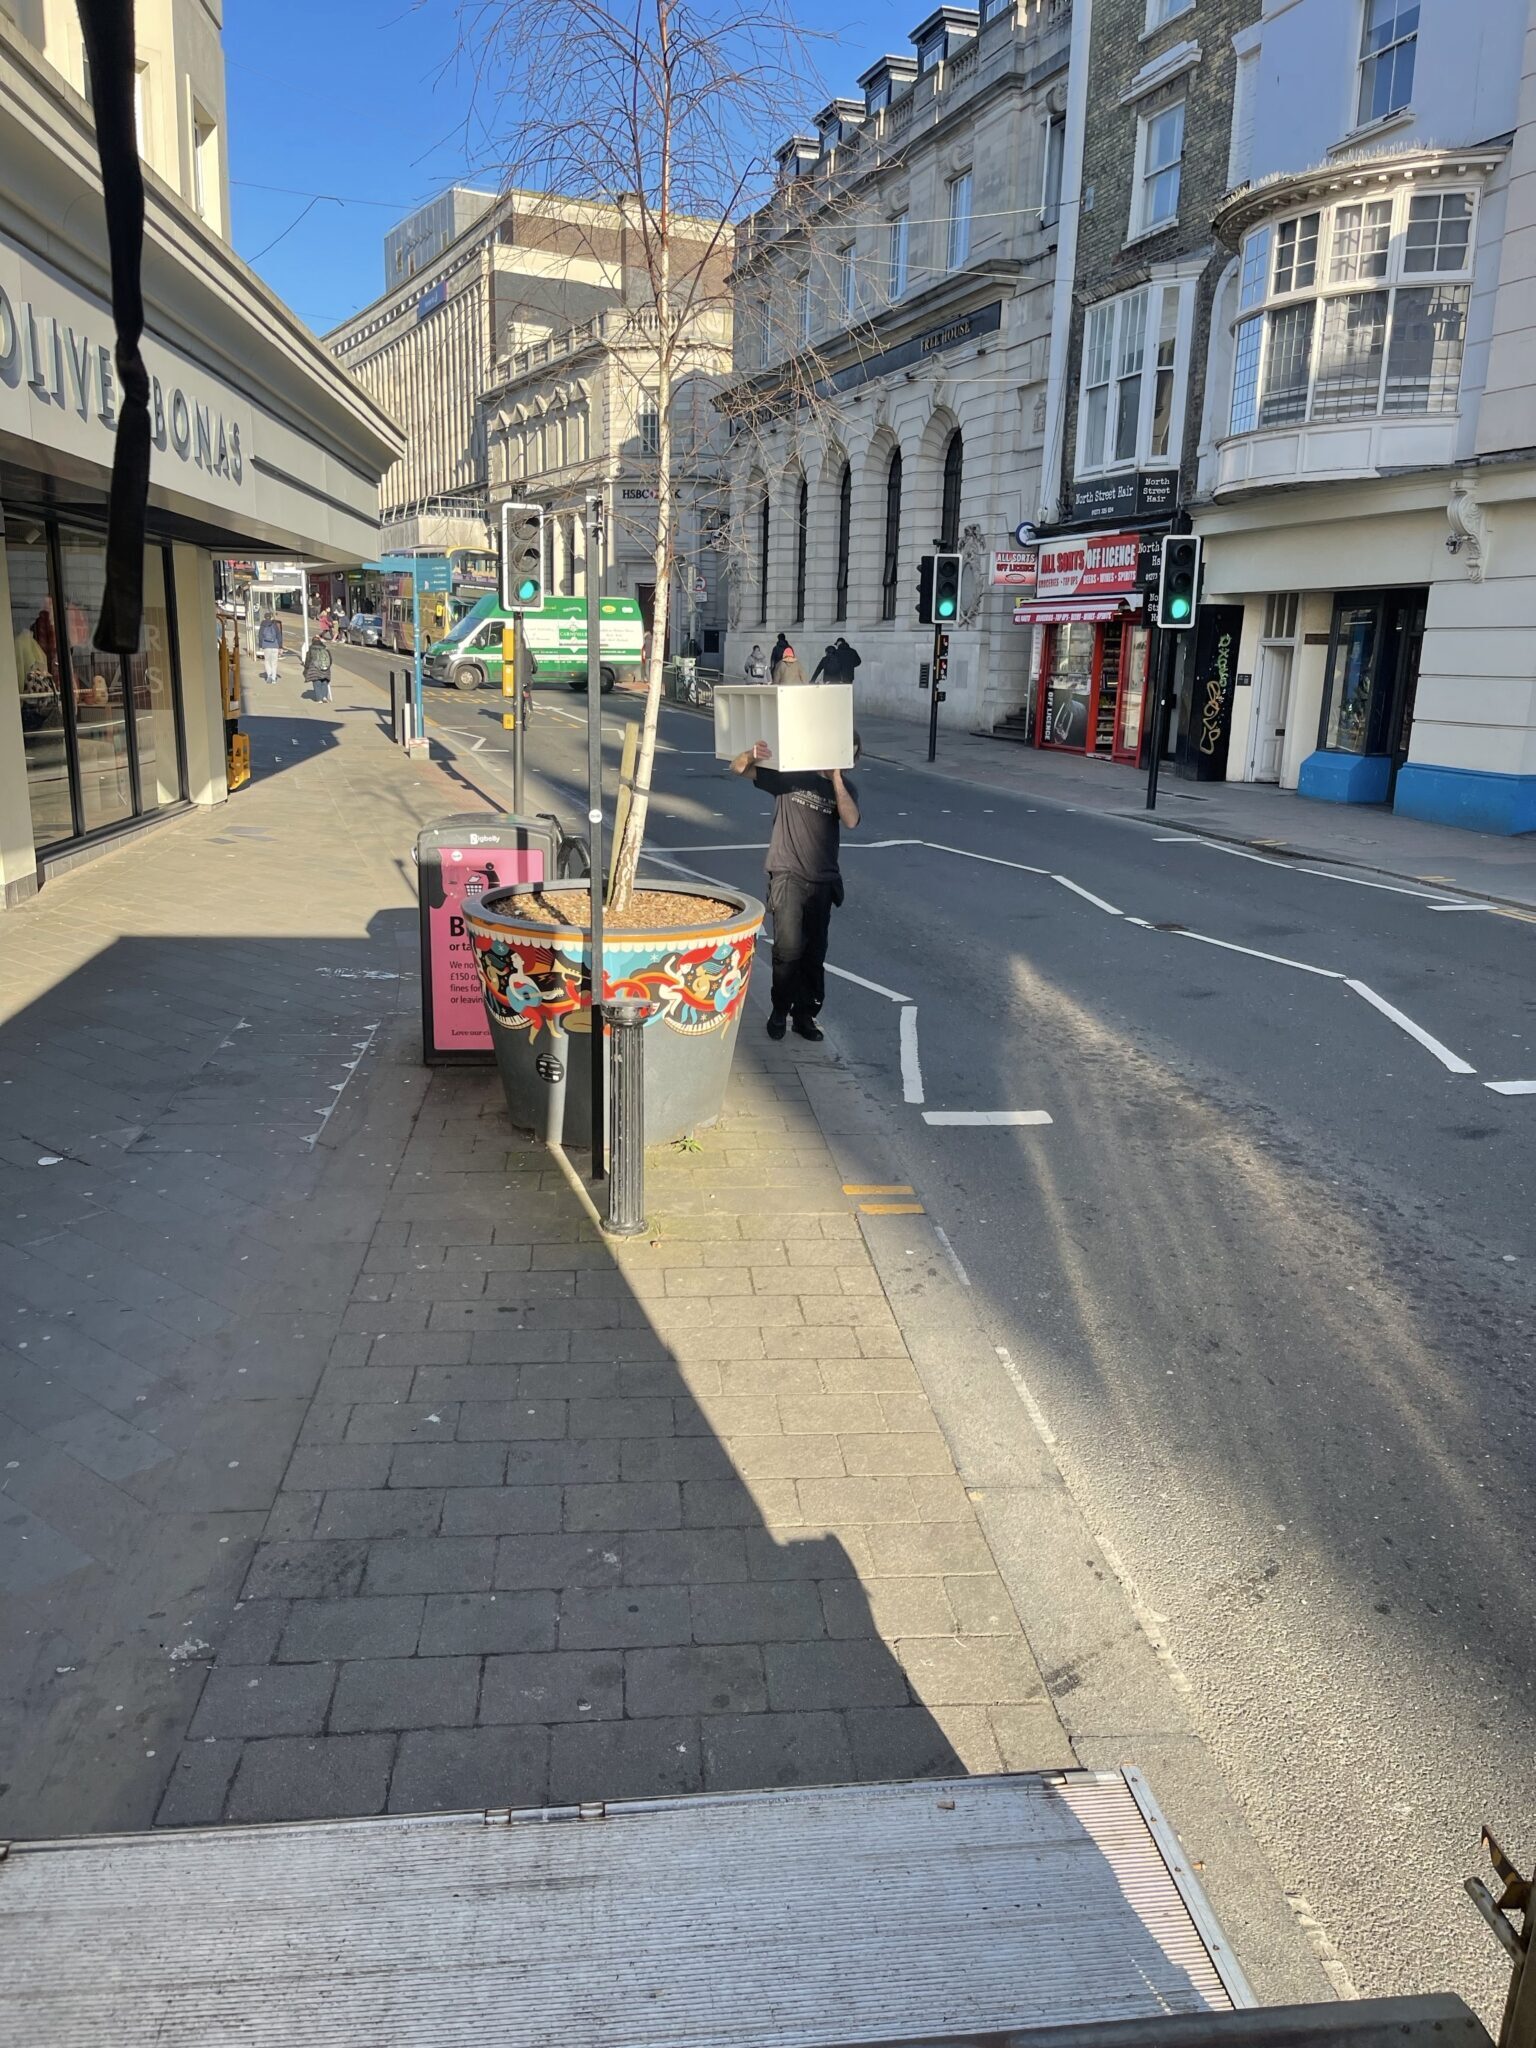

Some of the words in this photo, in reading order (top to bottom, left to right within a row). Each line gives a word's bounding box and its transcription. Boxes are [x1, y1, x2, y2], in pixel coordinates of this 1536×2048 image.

[920, 333, 941, 352] FREE
[941, 320, 971, 344] HOUSE
[0, 284, 121, 424] LIVE
[148, 374, 243, 478] BONAS
[1145, 478, 1170, 486] North
[622, 489, 650, 499] HSBC
[1075, 491, 1094, 504] North
[1095, 488, 1116, 503] Street
[1117, 485, 1134, 498] Hair
[1142, 487, 1171, 495] Street
[1137, 541, 1160, 553] North
[997, 553, 1011, 562] ALL
[1012, 553, 1035, 563] SORTS
[1041, 554, 1056, 574] ALL
[1057, 550, 1085, 573] SORTS
[1086, 547, 1101, 569] OFF
[1101, 544, 1136, 568] LICENCE
[1151, 556, 1161, 566] Ha
[996, 564, 1009, 572] OFF
[1009, 564, 1035, 572] LICENCE
[1045, 708, 1053, 741] LICENCE
[470, 833, 500, 845] Bigbelly
[462, 943, 472, 951] ta
[450, 961, 462, 969] We
[450, 973, 469, 981] £150
[450, 984, 469, 992] fines
[460, 996, 483, 1004] leavin
